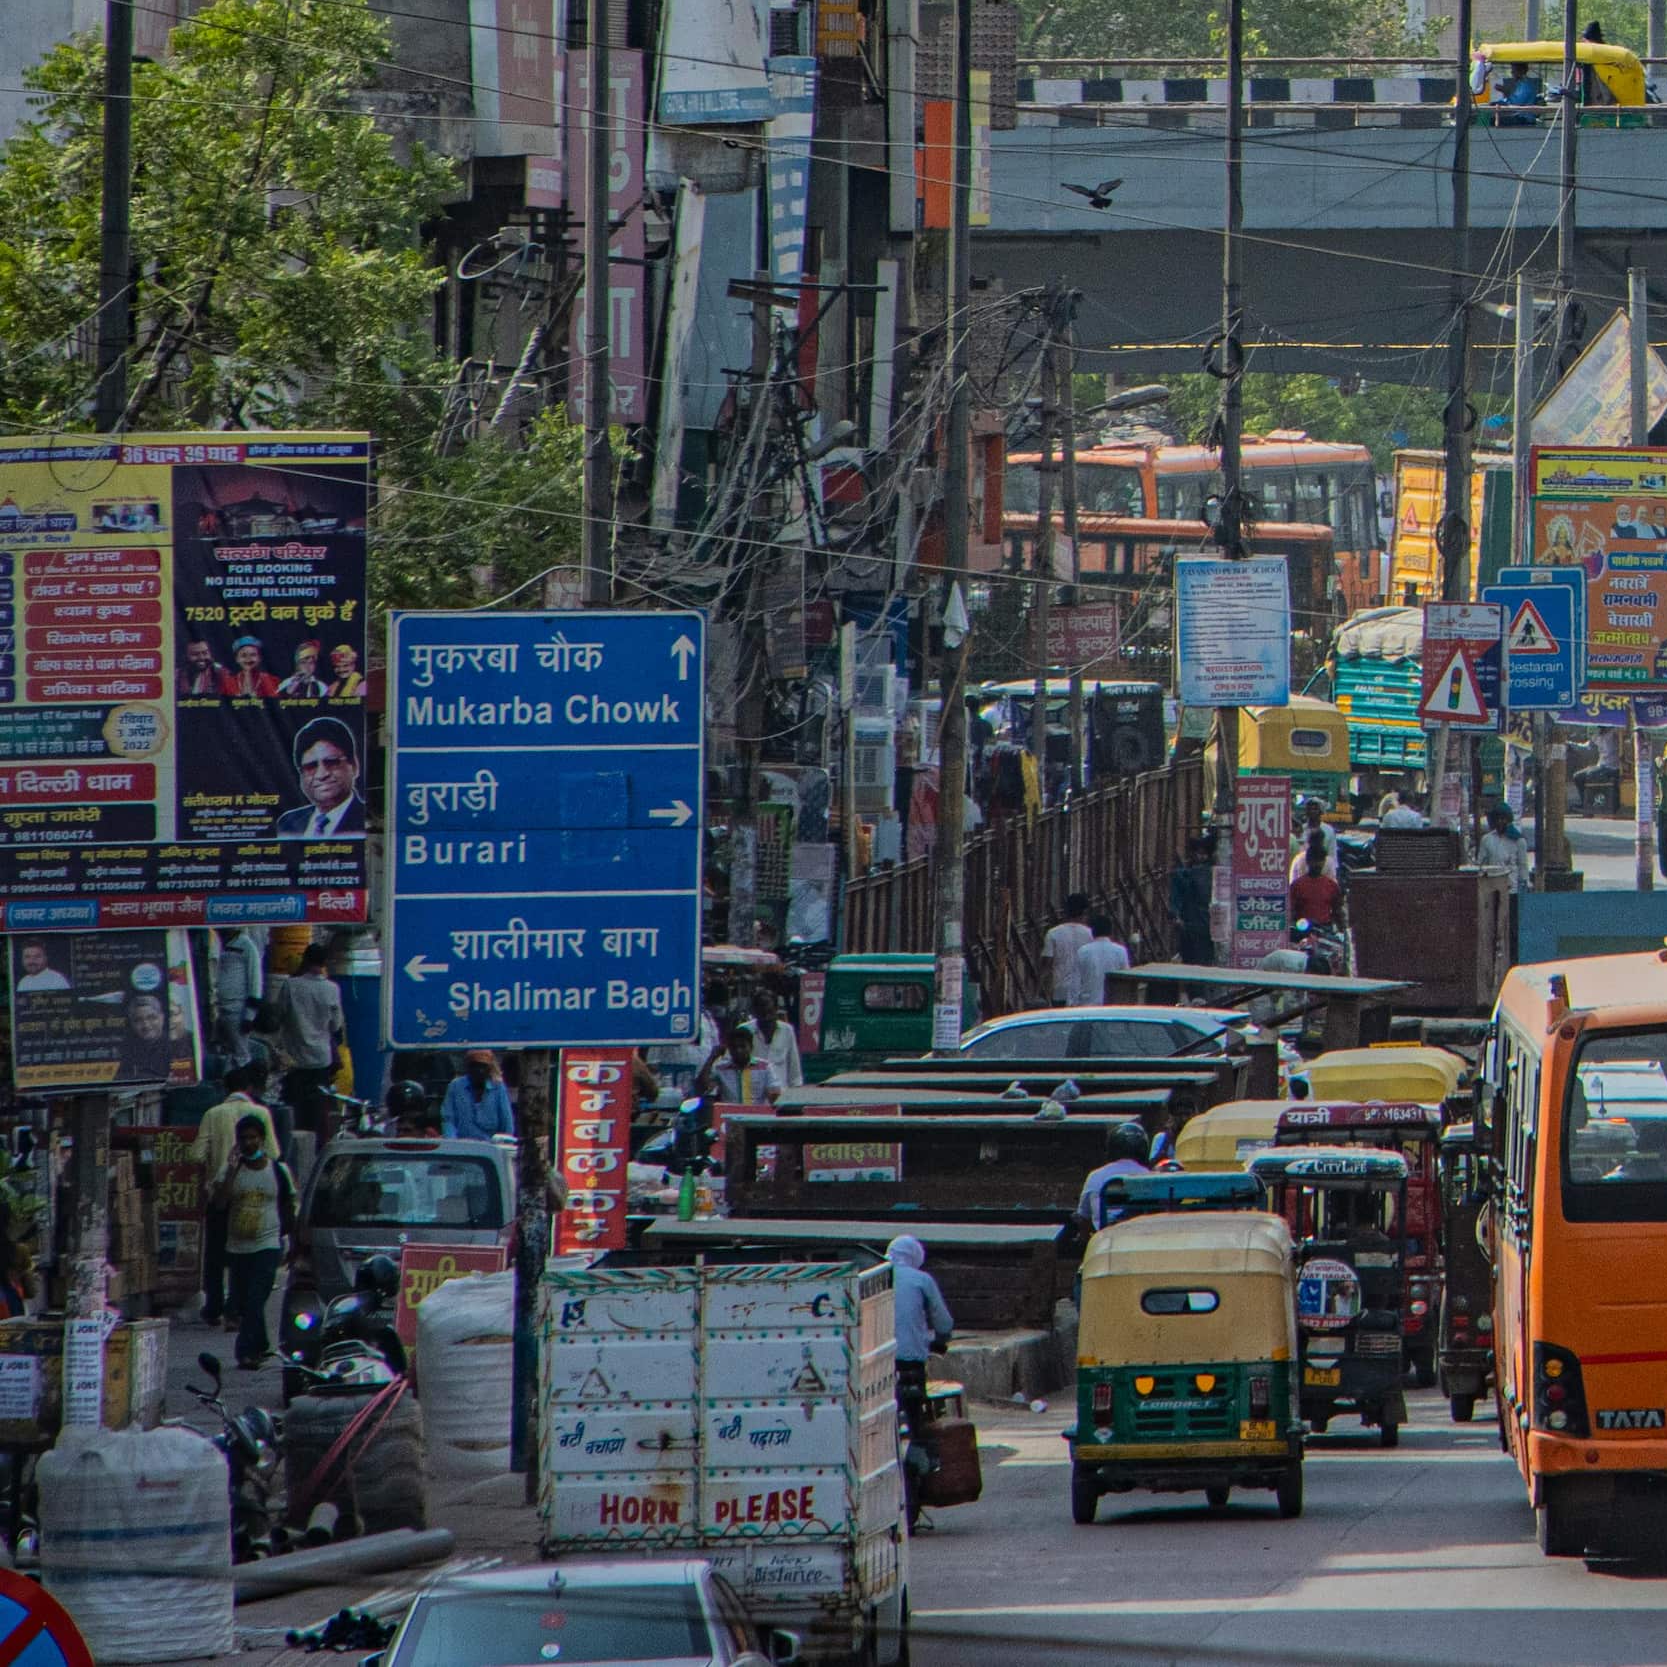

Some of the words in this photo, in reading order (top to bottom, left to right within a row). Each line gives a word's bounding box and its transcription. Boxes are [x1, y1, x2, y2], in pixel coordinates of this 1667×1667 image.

[228, 564, 253, 574] FOR
[256, 563, 313, 574] BOOKING
[205, 576, 223, 586] NO
[226, 575, 275, 586] BILLING
[277, 574, 336, 585] COUNTER
[222, 588, 260, 599] (ZERO
[184, 606, 225, 622] 7520
[271, 605, 300, 621] बन
[303, 602, 337, 626] चुके
[339, 599, 358, 622] हैं
[408, 643, 520, 687] मुकरबा
[534, 630, 605, 673] चौक
[97, 681, 146, 694] वाटिका
[1214, 683, 1236, 692] OPEN
[1509, 676, 1554, 689] rossing
[406, 695, 553, 727] Mukarba
[564, 693, 681, 725] Chowk
[123, 741, 151, 751] 2022
[15, 769, 82, 793] दिल्ली
[86, 773, 133, 791] धाम
[406, 769, 499, 827] बुराड़ी
[3, 811, 47, 829] गुप्ता
[1238, 797, 1287, 858] गुप्ता
[404, 833, 527, 865] Burari
[1259, 841, 1287, 873] स्टोर
[318, 892, 356, 911] दिल्ली
[1239, 896, 1283, 912] जैकेट
[449, 917, 587, 961] शालीमार
[600, 928, 660, 958] बाग
[449, 980, 597, 1012] Shalimar
[606, 978, 691, 1017] Bagh
[1286, 1107, 1330, 1125] यात्री
[1598, 1410, 1663, 1429] TATA
[599, 1491, 681, 1526] HORN
[714, 1485, 815, 1523] PLEASE
